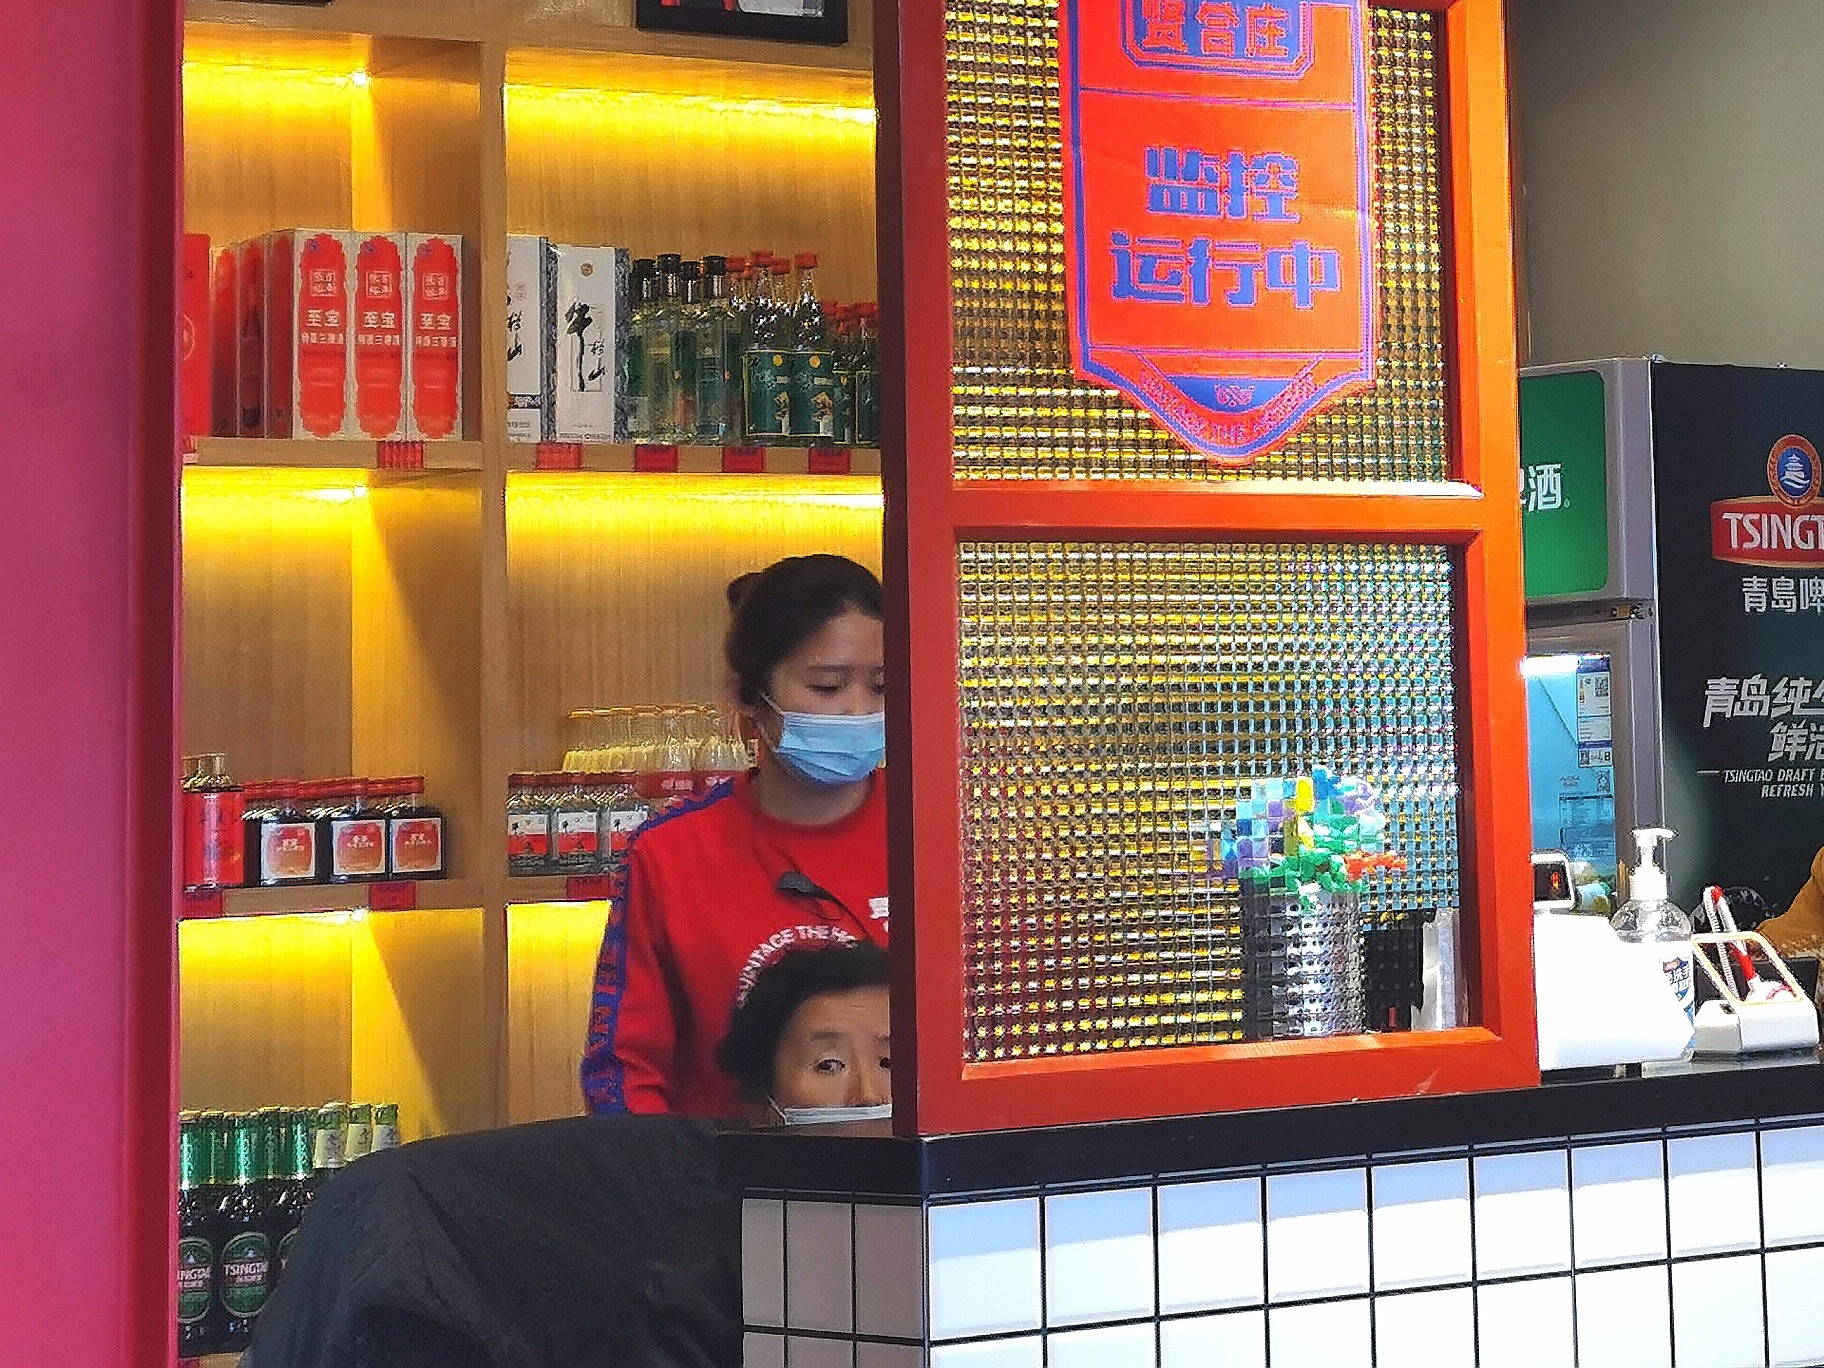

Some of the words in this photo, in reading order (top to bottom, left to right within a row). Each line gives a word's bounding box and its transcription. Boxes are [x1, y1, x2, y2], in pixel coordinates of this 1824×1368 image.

[1145, 145, 1301, 223] 监控
[1109, 232, 1342, 310] 运行中
[1519, 463, 1562, 512] 酒
[1723, 769, 1773, 783] TSINGTAO
[1777, 768, 1816, 782] DRAFT
[1761, 783, 1814, 799] REFRESH
